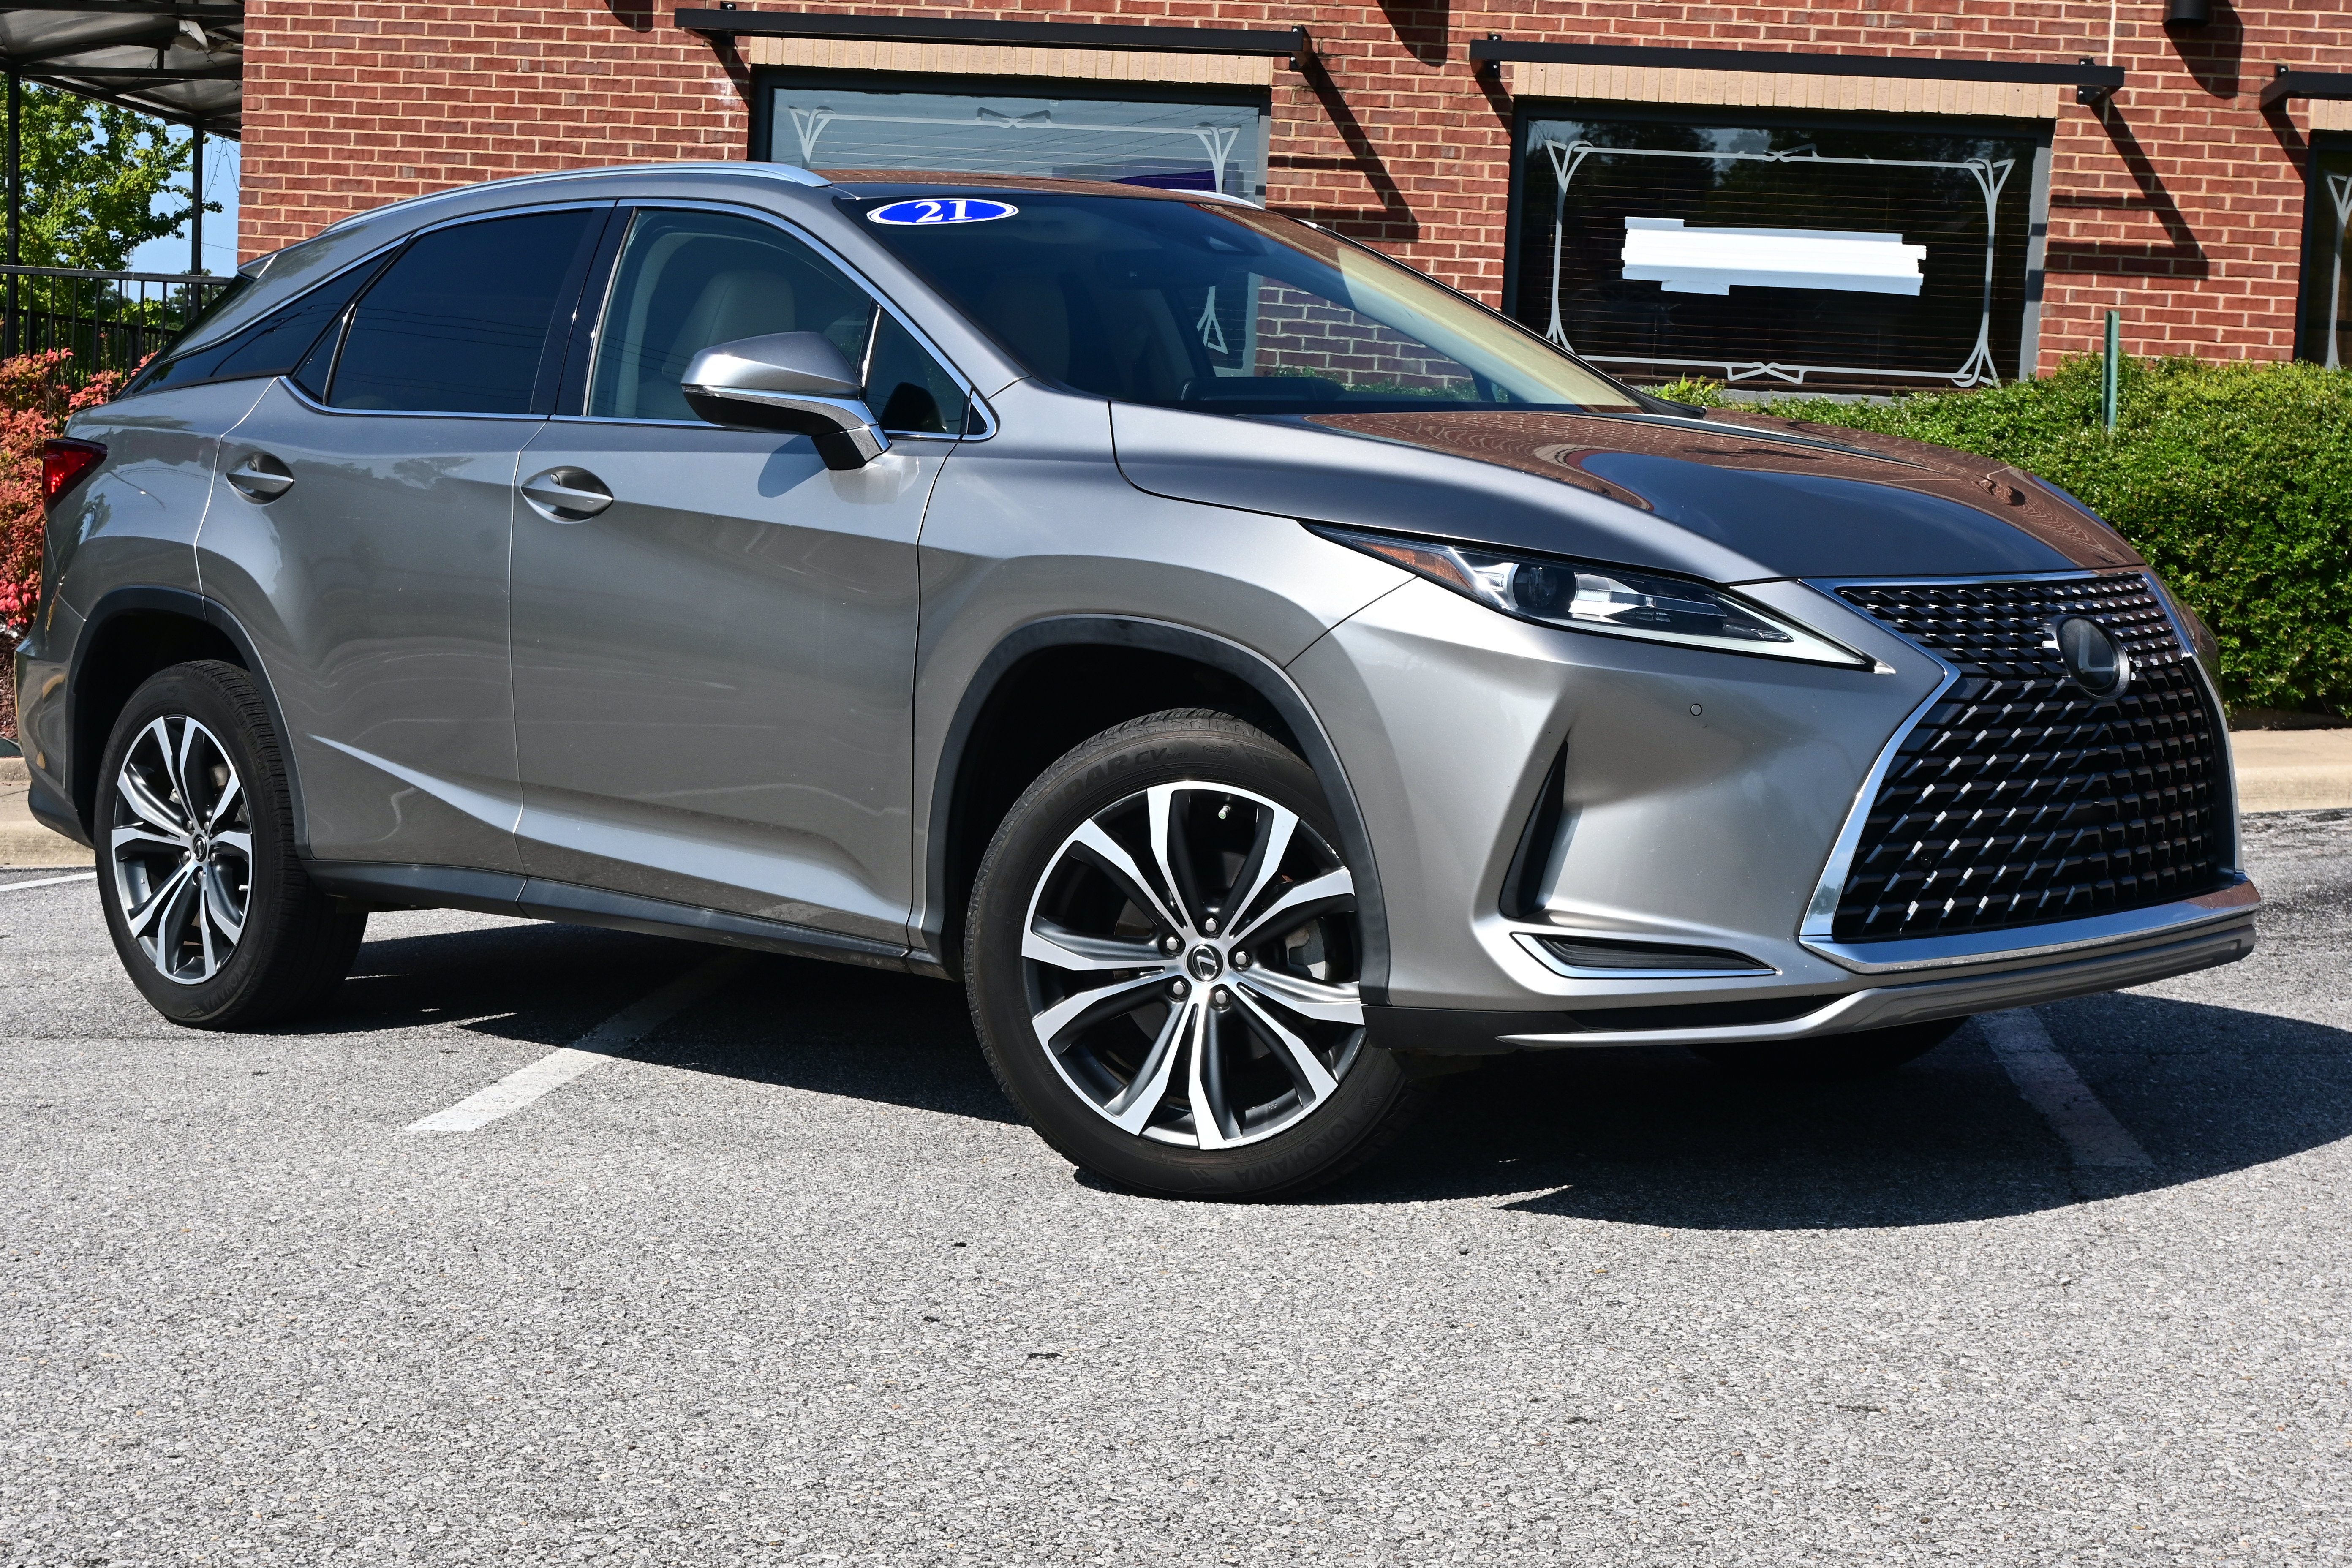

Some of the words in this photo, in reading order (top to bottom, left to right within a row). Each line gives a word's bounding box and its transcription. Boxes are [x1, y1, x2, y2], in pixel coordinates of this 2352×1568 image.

[915, 200, 972, 223] 21
[1134, 747, 1167, 765] CV
[1234, 1115, 1359, 1187] YOKOHAMA
